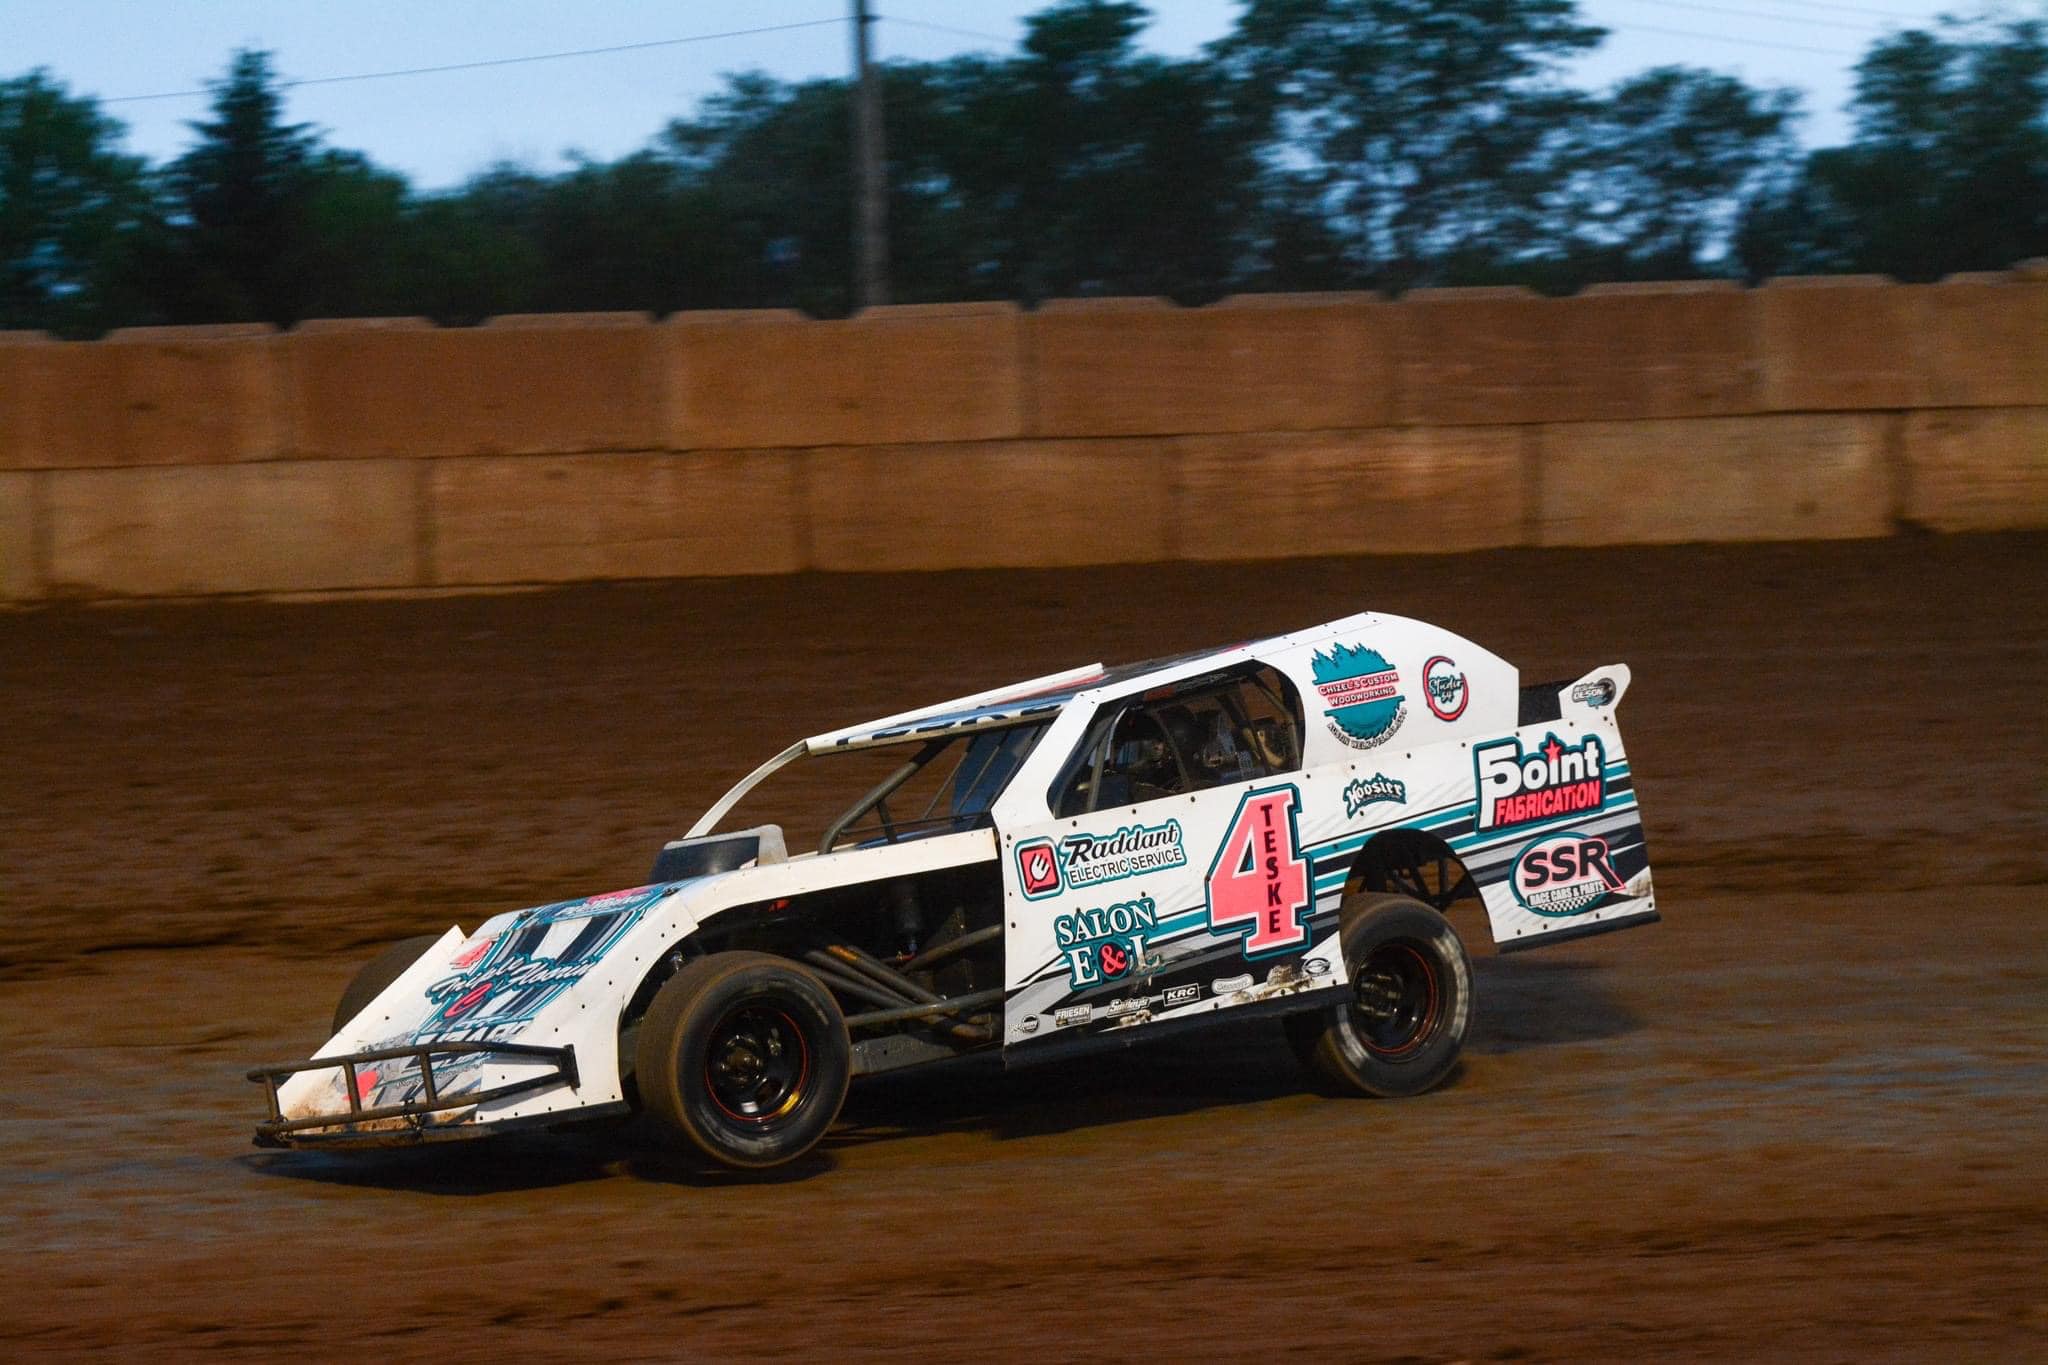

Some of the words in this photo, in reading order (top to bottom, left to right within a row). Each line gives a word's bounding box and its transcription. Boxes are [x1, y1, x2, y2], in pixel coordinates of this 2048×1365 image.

[1328, 686, 1396, 707] WOODWORKING
[1360, 672, 1399, 687] CUSTOM
[1345, 777, 1403, 813] Hoosier
[1064, 824, 1179, 866] Raddant
[1522, 839, 1624, 889] SSR
[1069, 861, 1129, 883] ELECTRIC
[1129, 847, 1182, 870] SERVICE
[1207, 788, 1309, 954] 4
[1261, 803, 1283, 934] TESKE
[1550, 887, 1572, 902] CARS
[1580, 880, 1605, 896] PARTS
[1057, 902, 1154, 945] SALON
